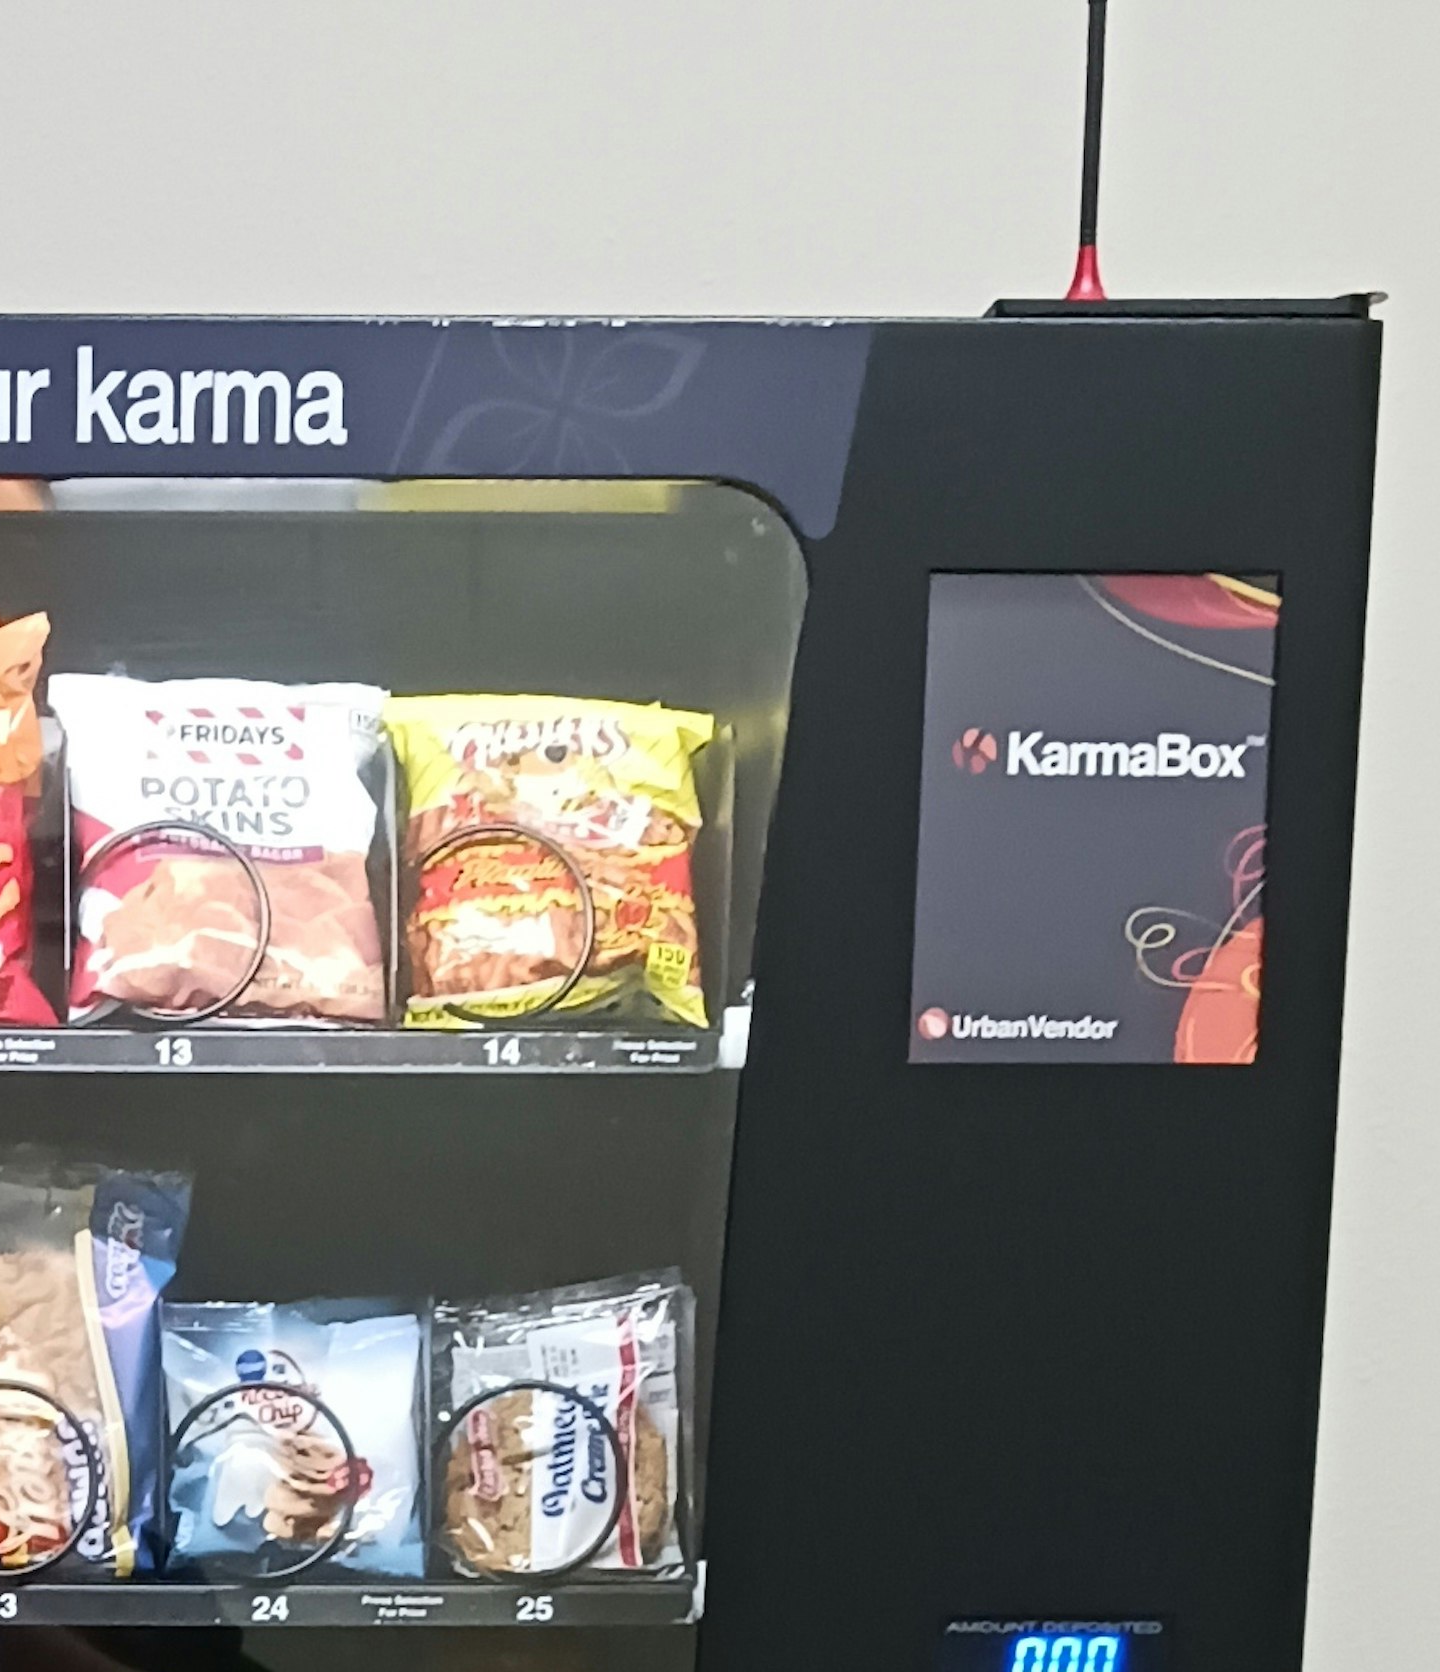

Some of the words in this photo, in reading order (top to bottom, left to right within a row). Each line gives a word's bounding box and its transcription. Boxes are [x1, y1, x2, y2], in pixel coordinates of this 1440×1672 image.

[76, 345, 347, 446] karma
[180, 725, 285, 745] FRIDAYS
[1007, 731, 1247, 778] KarmaBox
[141, 776, 311, 808] POTATO
[164, 807, 294, 836] SKINS
[951, 1014, 1118, 1039] UrbanVendor
[156, 1039, 192, 1065] 13
[483, 1039, 520, 1064] 14
[251, 1597, 289, 1621] 24
[517, 1597, 553, 1622] 25
[946, 1622, 1038, 1635] AMOUNT
[1042, 1621, 1163, 1635] DEPOSITED
